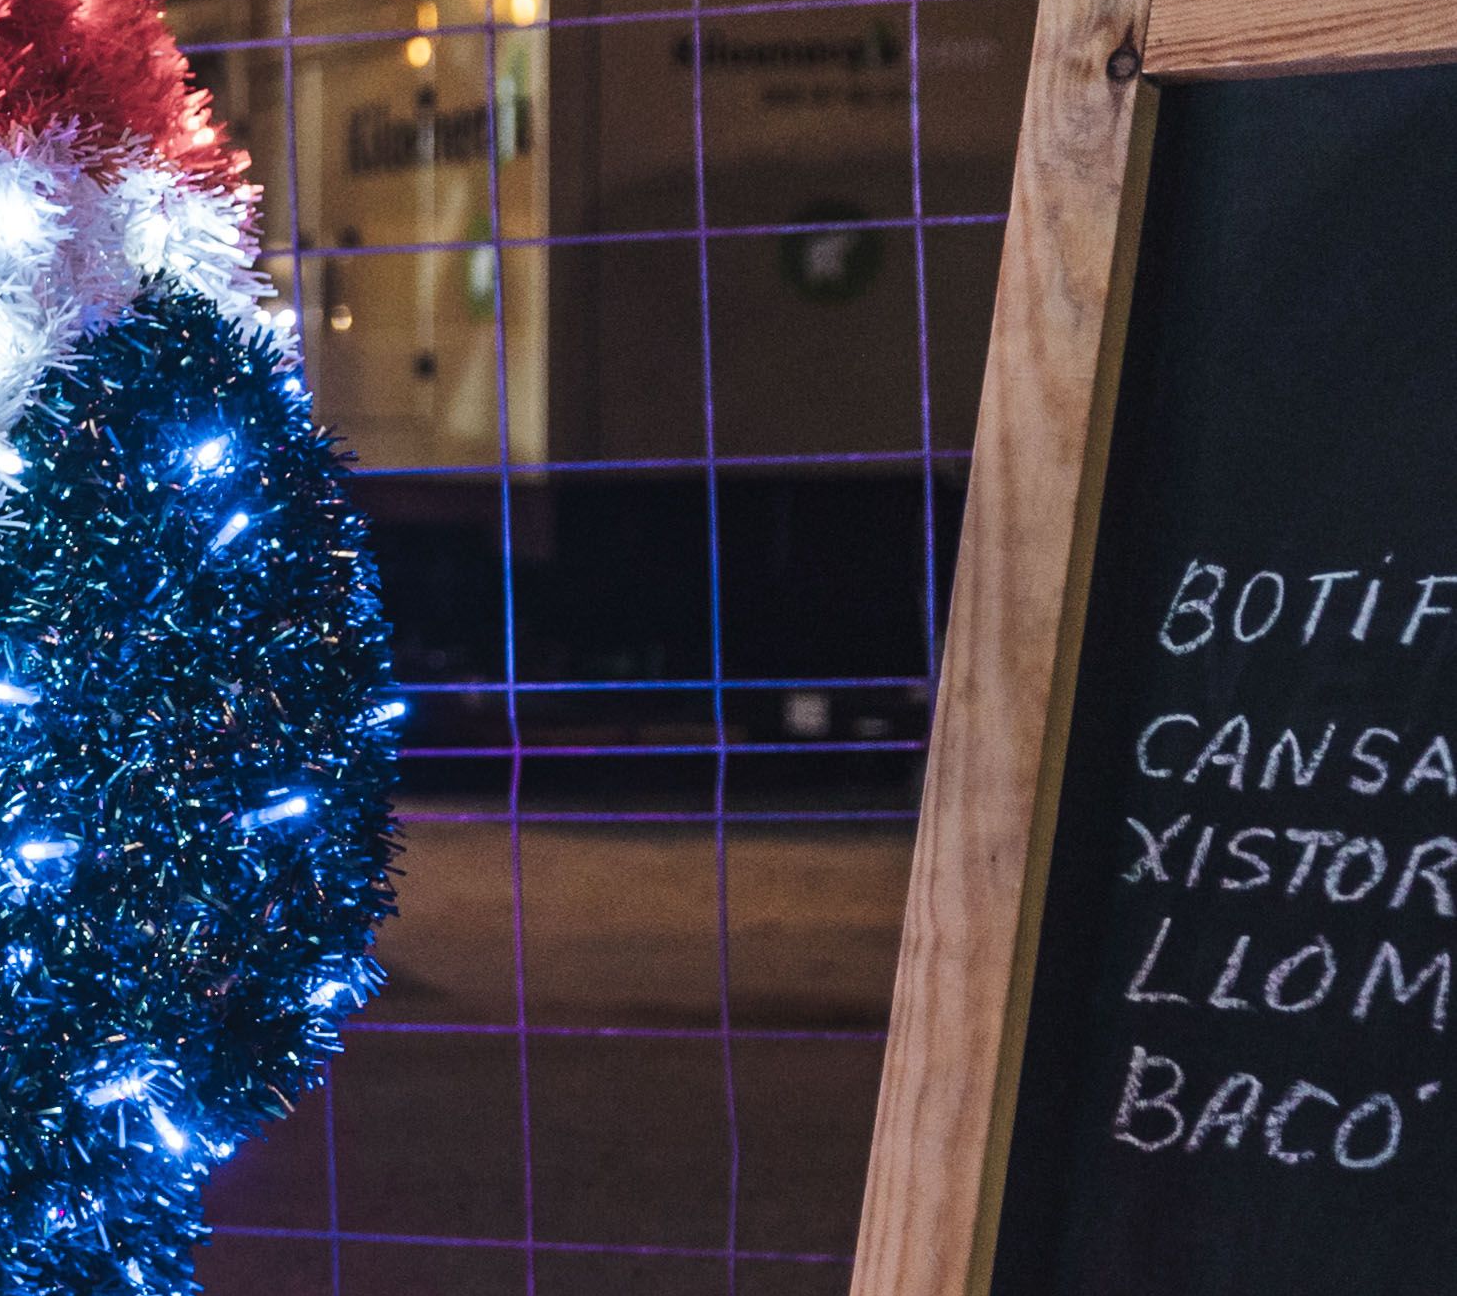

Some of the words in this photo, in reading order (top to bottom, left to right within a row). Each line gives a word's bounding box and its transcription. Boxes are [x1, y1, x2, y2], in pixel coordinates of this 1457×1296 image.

[1136, 713, 1457, 795] CANSA
[1123, 814, 1457, 916] XISTOR
[1126, 916, 1452, 1032] LLOM
